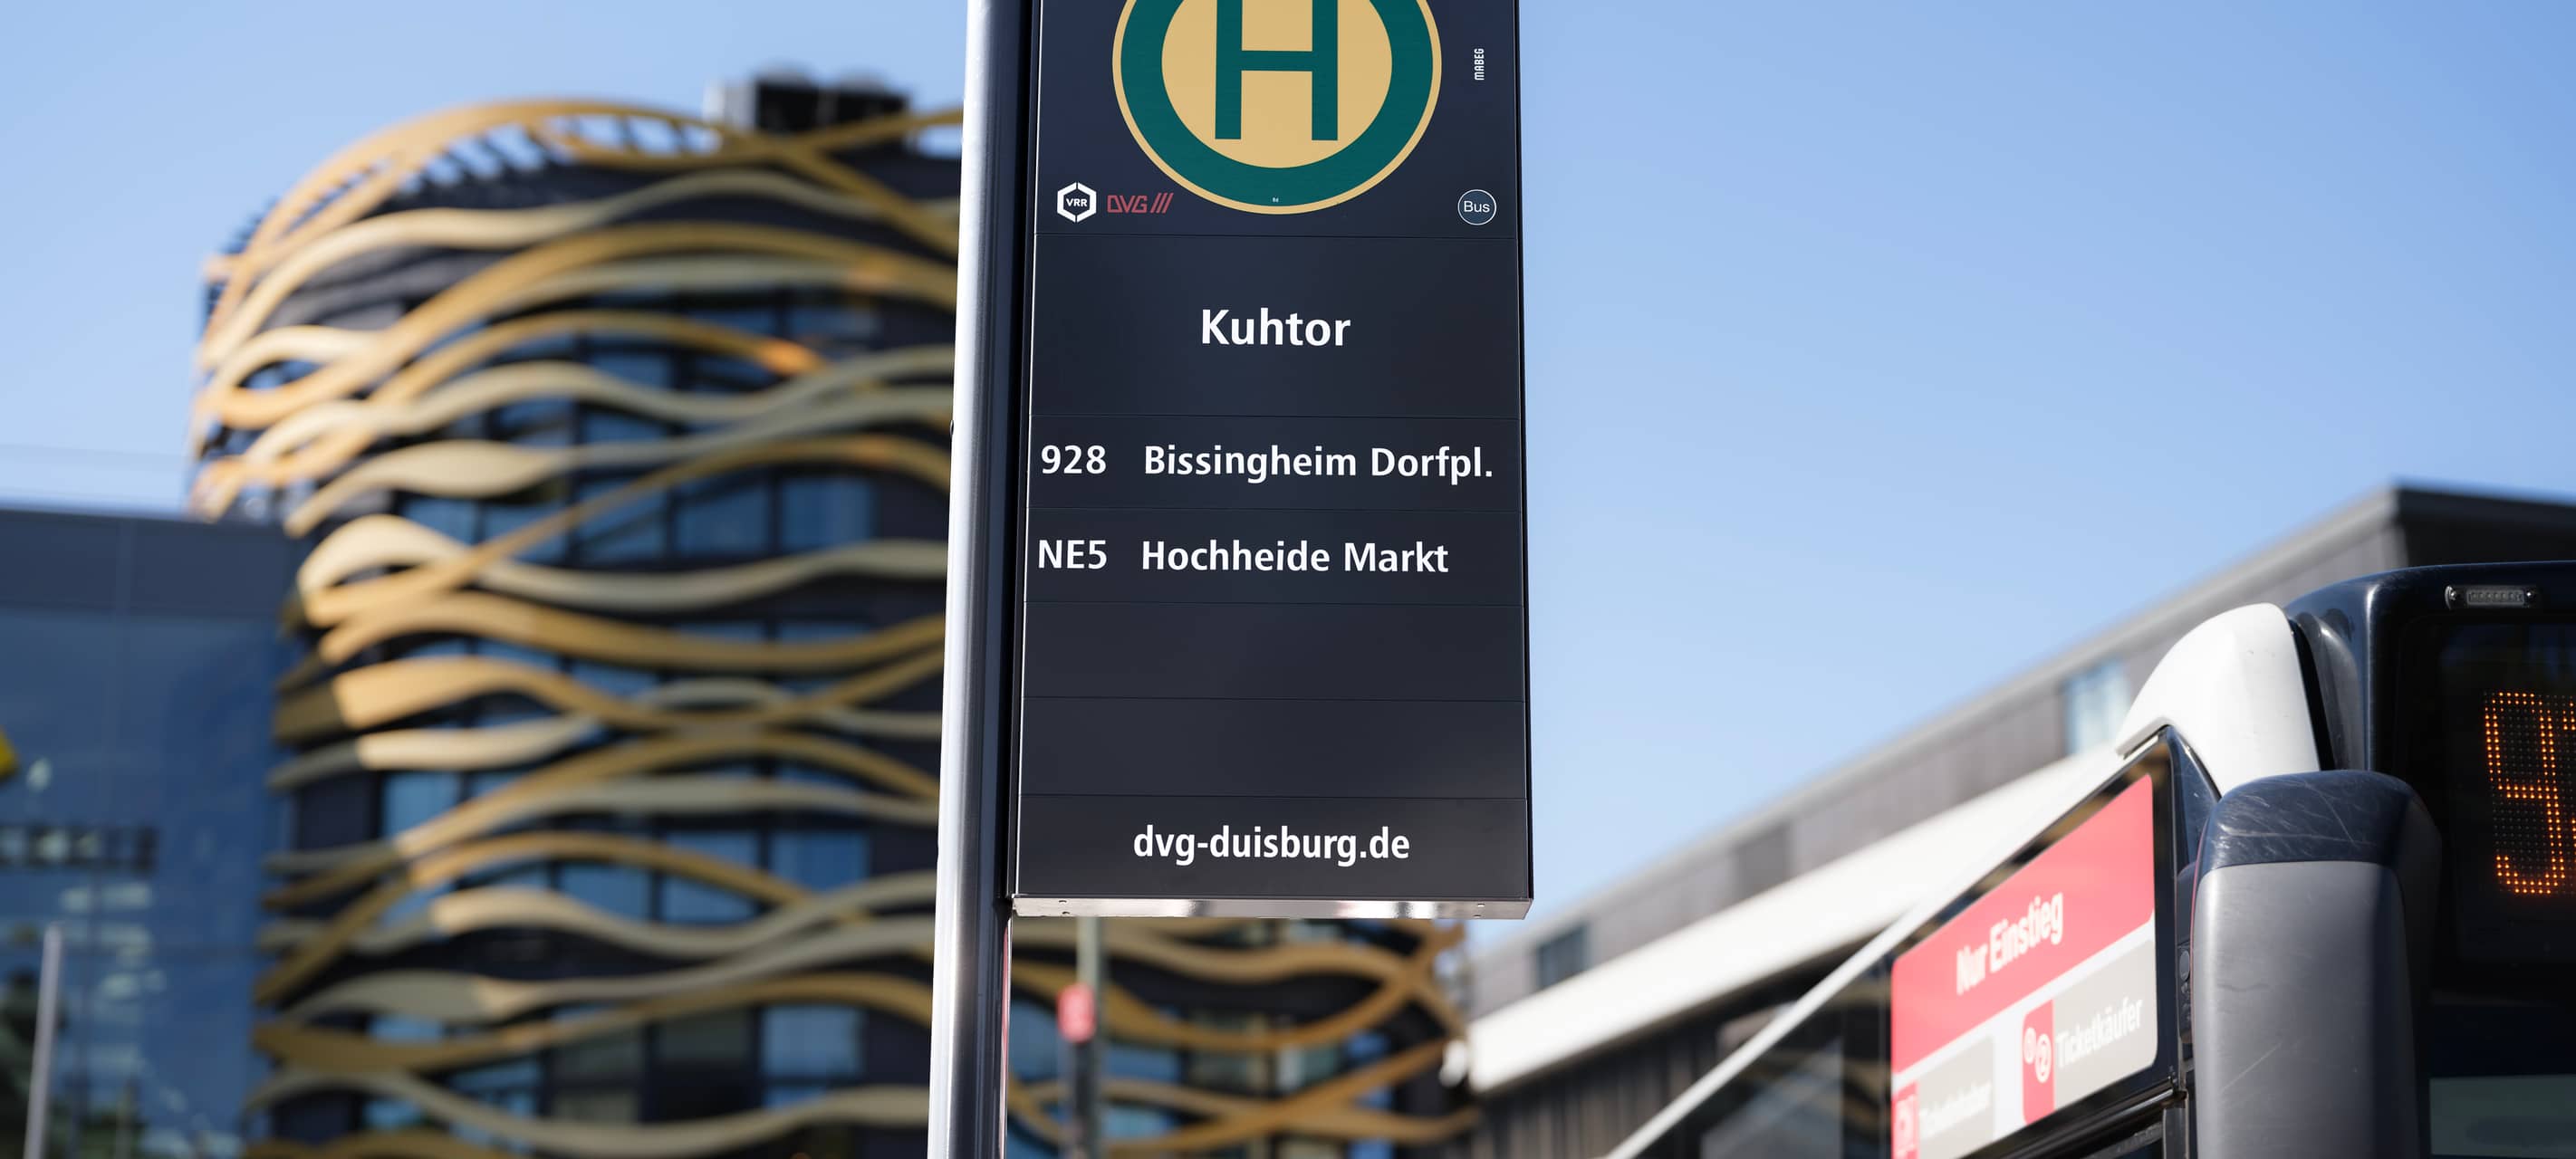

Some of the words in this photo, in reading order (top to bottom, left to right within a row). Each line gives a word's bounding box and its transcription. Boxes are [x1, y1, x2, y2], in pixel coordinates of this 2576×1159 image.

[1215, 0, 1338, 140] H
[1474, 48, 1485, 81] MABEG
[1065, 197, 1088, 207] VRR
[1464, 200, 1491, 214] Bus
[1201, 307, 1351, 347] Kuhtor
[1041, 445, 1107, 474] 928
[1145, 444, 1357, 484] Bissingheim
[1371, 445, 1494, 485] Dorfpl.
[1038, 540, 1108, 570] NE5
[1142, 540, 1331, 572] Hochheide
[1344, 541, 1449, 573] Markt
[2485, 692, 2576, 895] 9
[1133, 824, 1410, 867] dvg-duisburg.de
[1956, 942, 1988, 996] Nur
[1990, 892, 2064, 973] Einstieg
[2054, 996, 2143, 1069] Ticketkäufer
